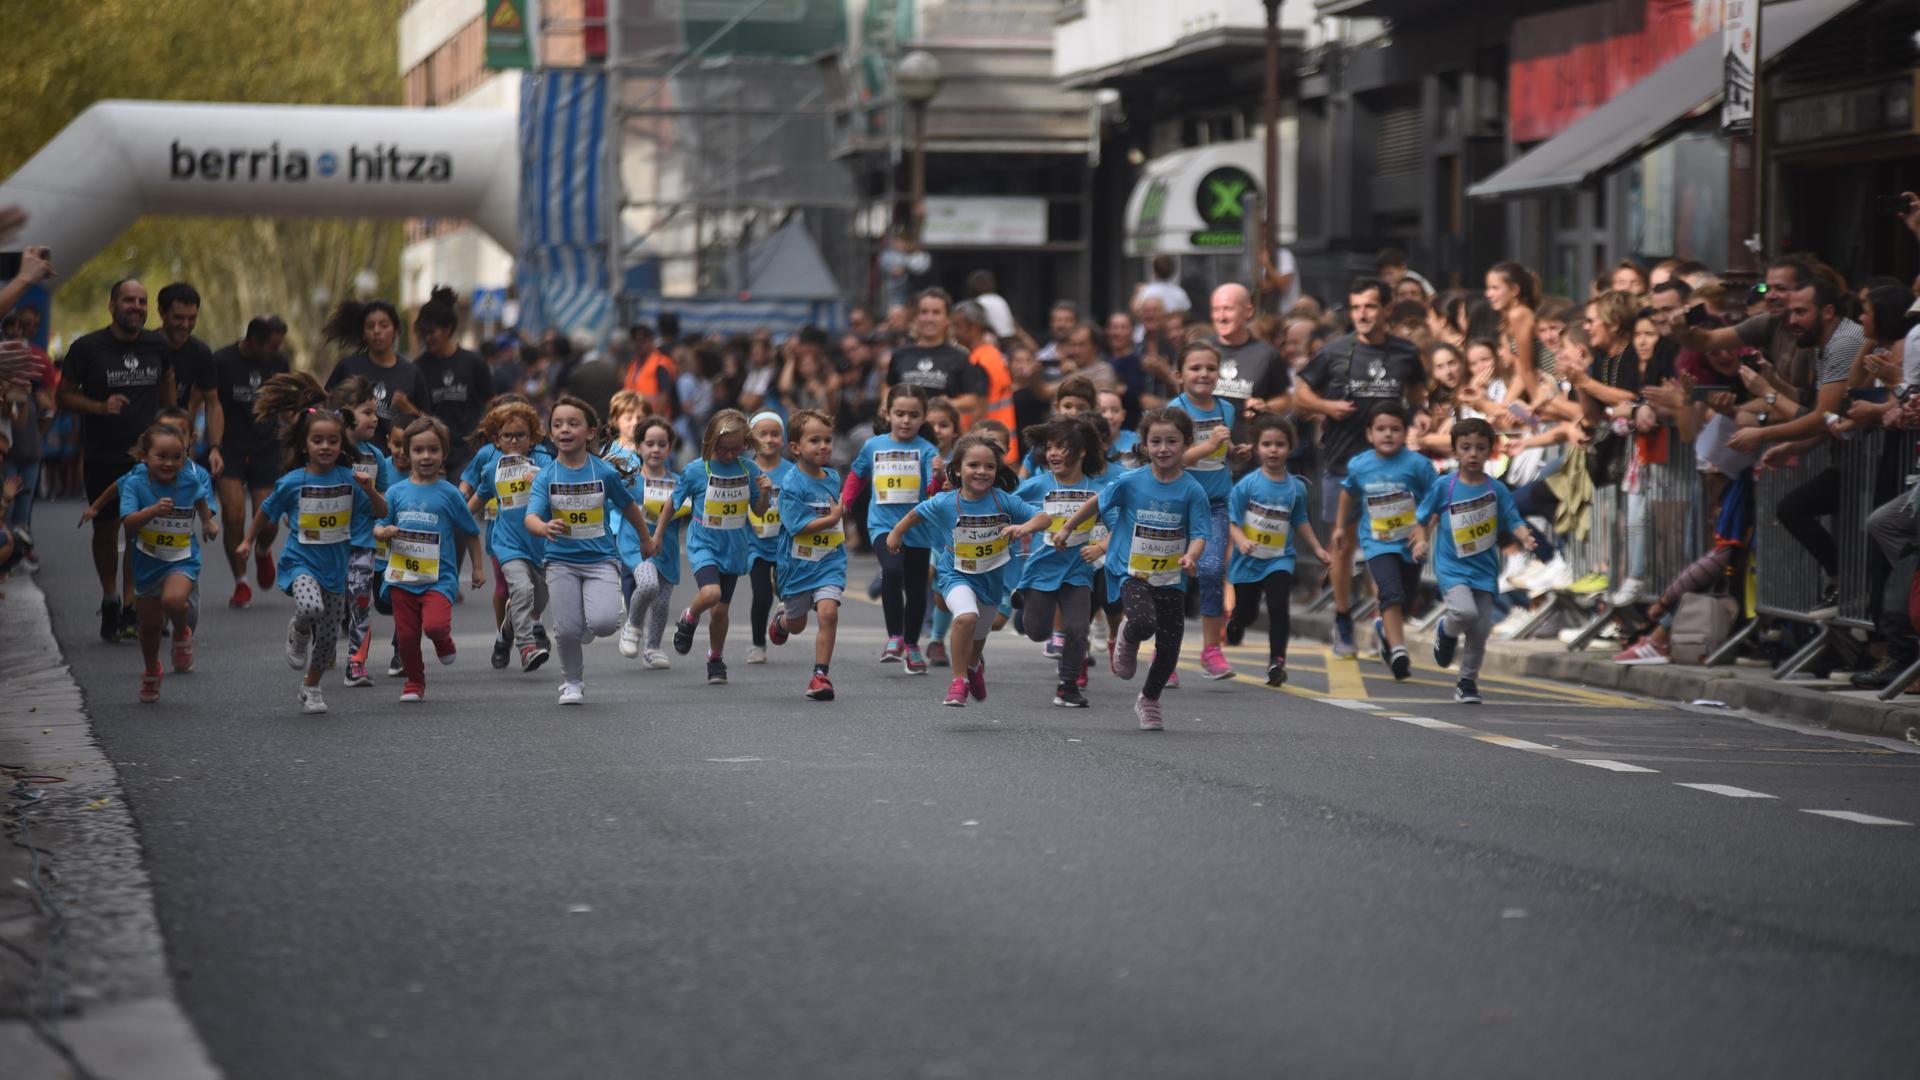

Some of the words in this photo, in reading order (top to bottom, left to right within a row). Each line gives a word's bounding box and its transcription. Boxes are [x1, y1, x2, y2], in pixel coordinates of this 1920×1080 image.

[171, 139, 309, 182] berria
[348, 142, 453, 183] hitza
[510, 480, 525, 493] 53
[887, 477, 901, 488] 81
[713, 488, 743, 499] NAHIA
[723, 504, 738, 515] 33
[319, 516, 337, 528] 60
[569, 513, 587, 524] 96
[1469, 523, 1491, 538] 100
[156, 534, 175, 546] 82
[813, 535, 829, 546] 94
[1256, 533, 1271, 545] 19
[975, 544, 993, 557] 35
[405, 559, 419, 572] 66
[1151, 559, 1169, 570] 77
